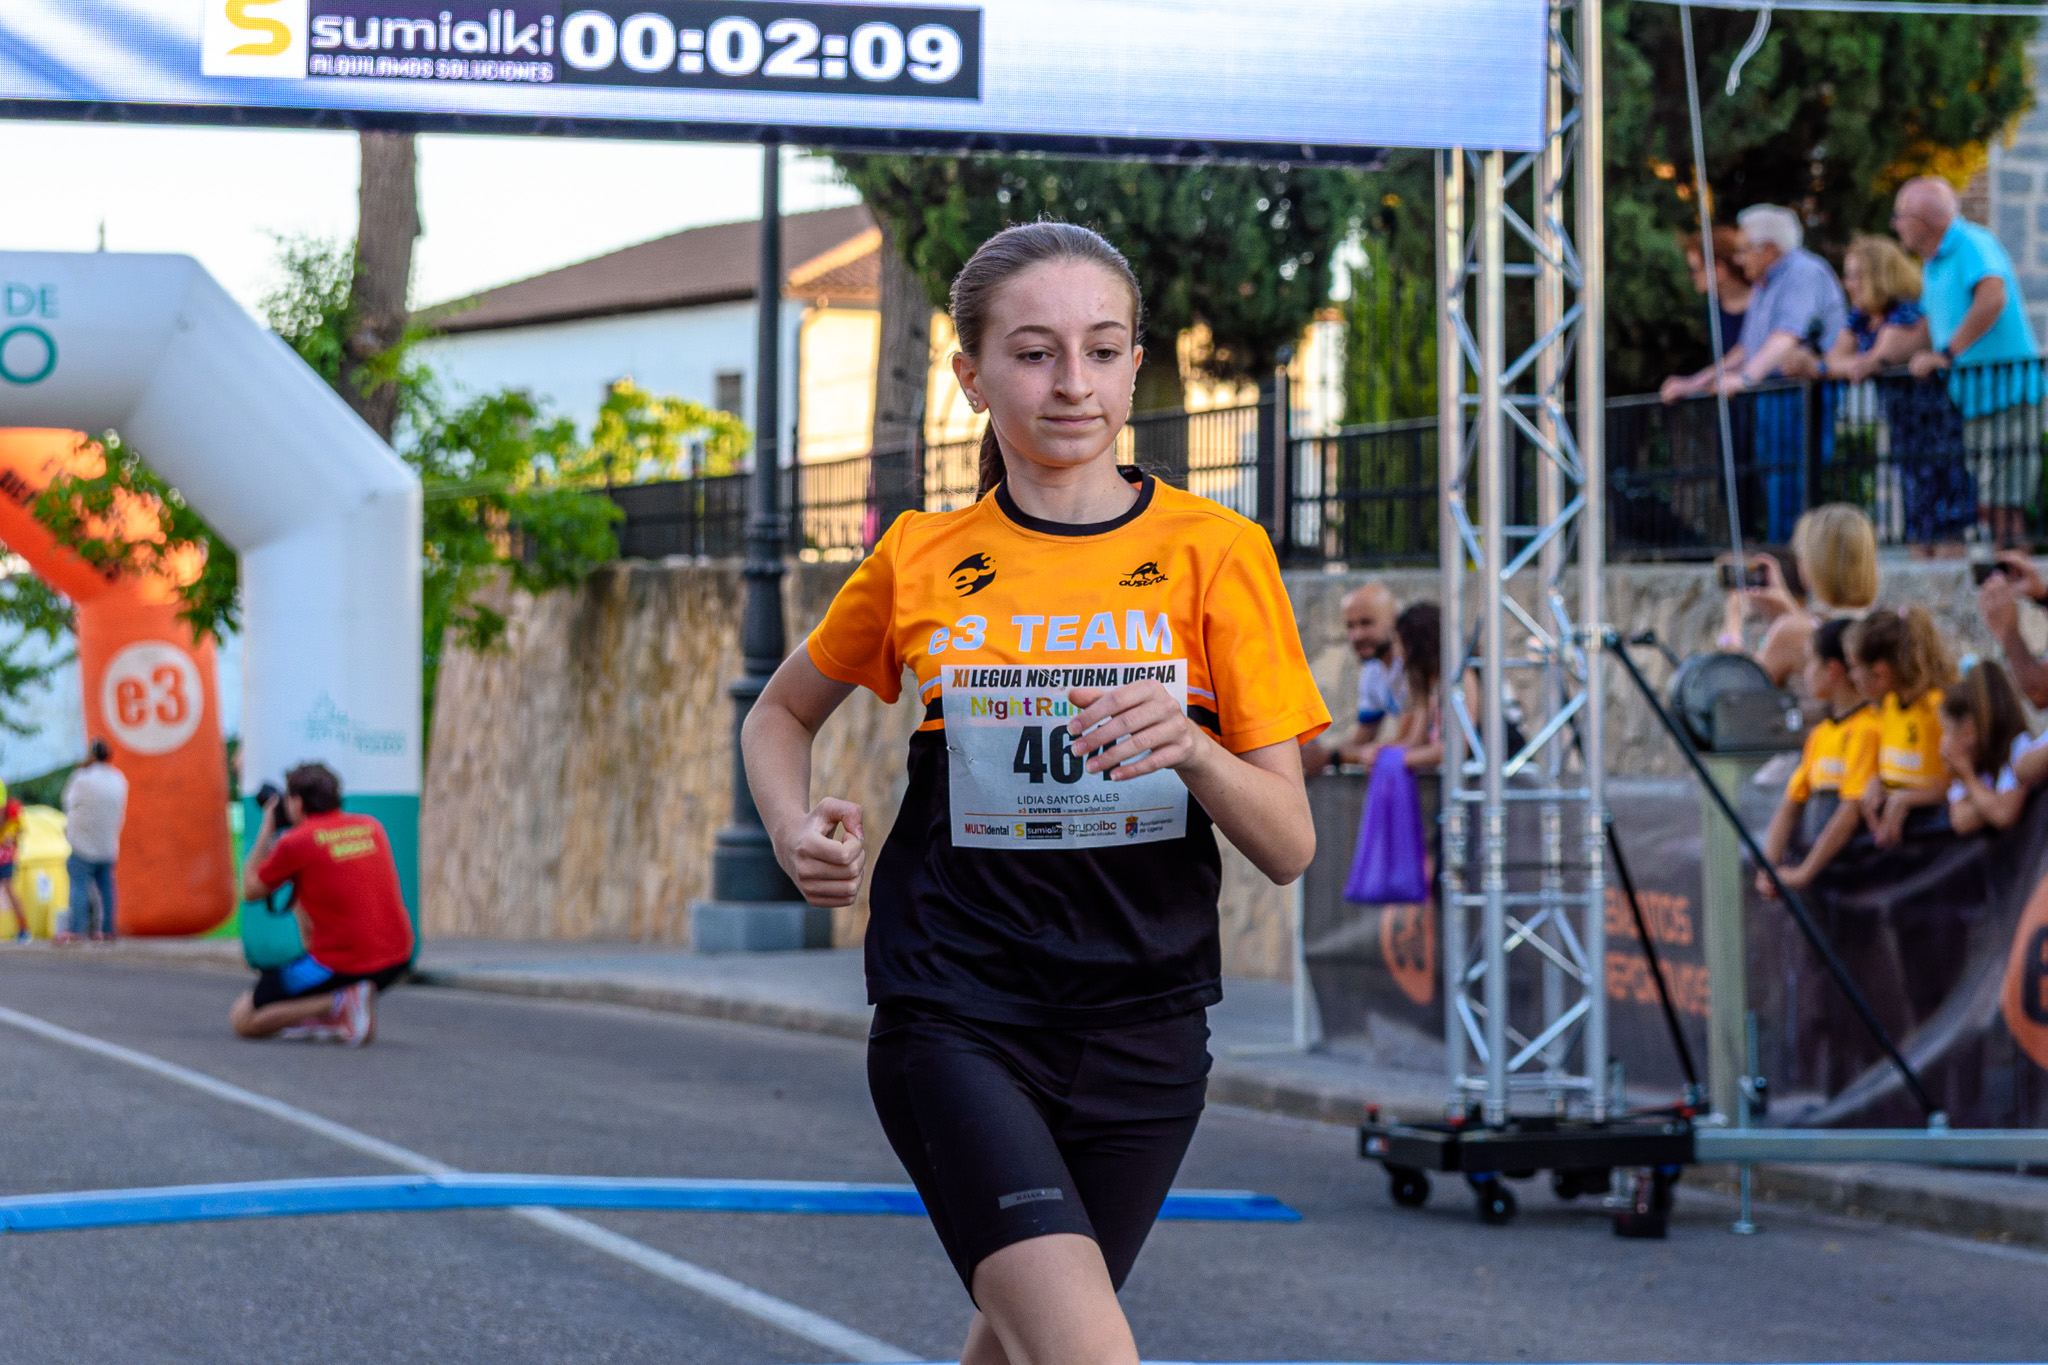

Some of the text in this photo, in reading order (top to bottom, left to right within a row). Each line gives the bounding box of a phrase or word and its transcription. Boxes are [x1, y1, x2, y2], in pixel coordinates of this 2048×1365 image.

[311, 9, 555, 56] sumialki
[560, 9, 963, 84] 00:02:09
[6, 282, 58, 318] DE
[928, 609, 1173, 655] e3 TEAM
[115, 666, 188, 727] e3
[952, 668, 970, 688] XI
[970, 669, 1022, 688] LEGUA
[1025, 668, 1119, 688] NOCTURNA
[970, 696, 1033, 720] Night
[1013, 725, 1122, 784] 46
[1017, 792, 1120, 805] LIDIA SANTOS ALES
[964, 823, 1010, 836] MULTIdental
